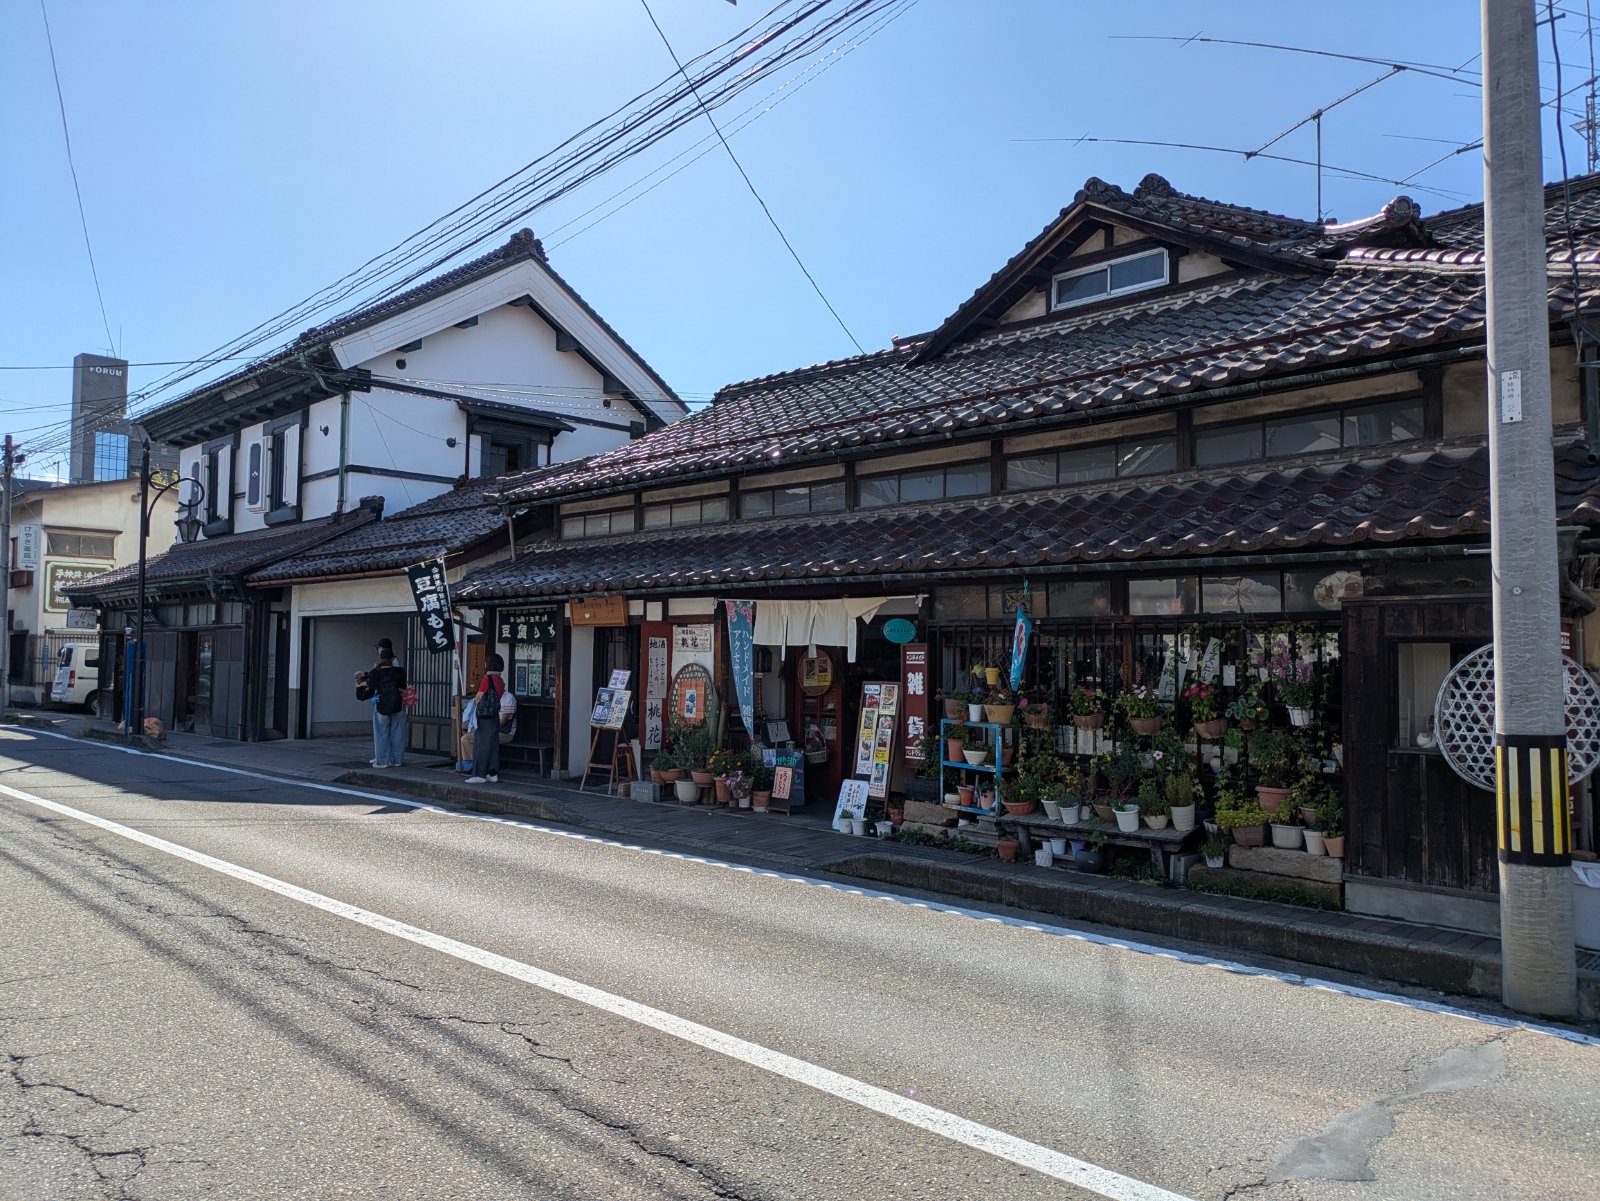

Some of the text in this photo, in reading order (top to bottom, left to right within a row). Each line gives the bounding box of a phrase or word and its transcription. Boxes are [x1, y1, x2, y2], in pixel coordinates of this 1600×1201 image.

[90, 366, 122, 376] FORUM
[414, 575, 449, 649] 豆腐もち
[650, 639, 666, 649] 地酒
[741, 630, 750, 697] ハンドメイド
[647, 702, 662, 744] 桃花
[907, 672, 925, 740] 雑貨
